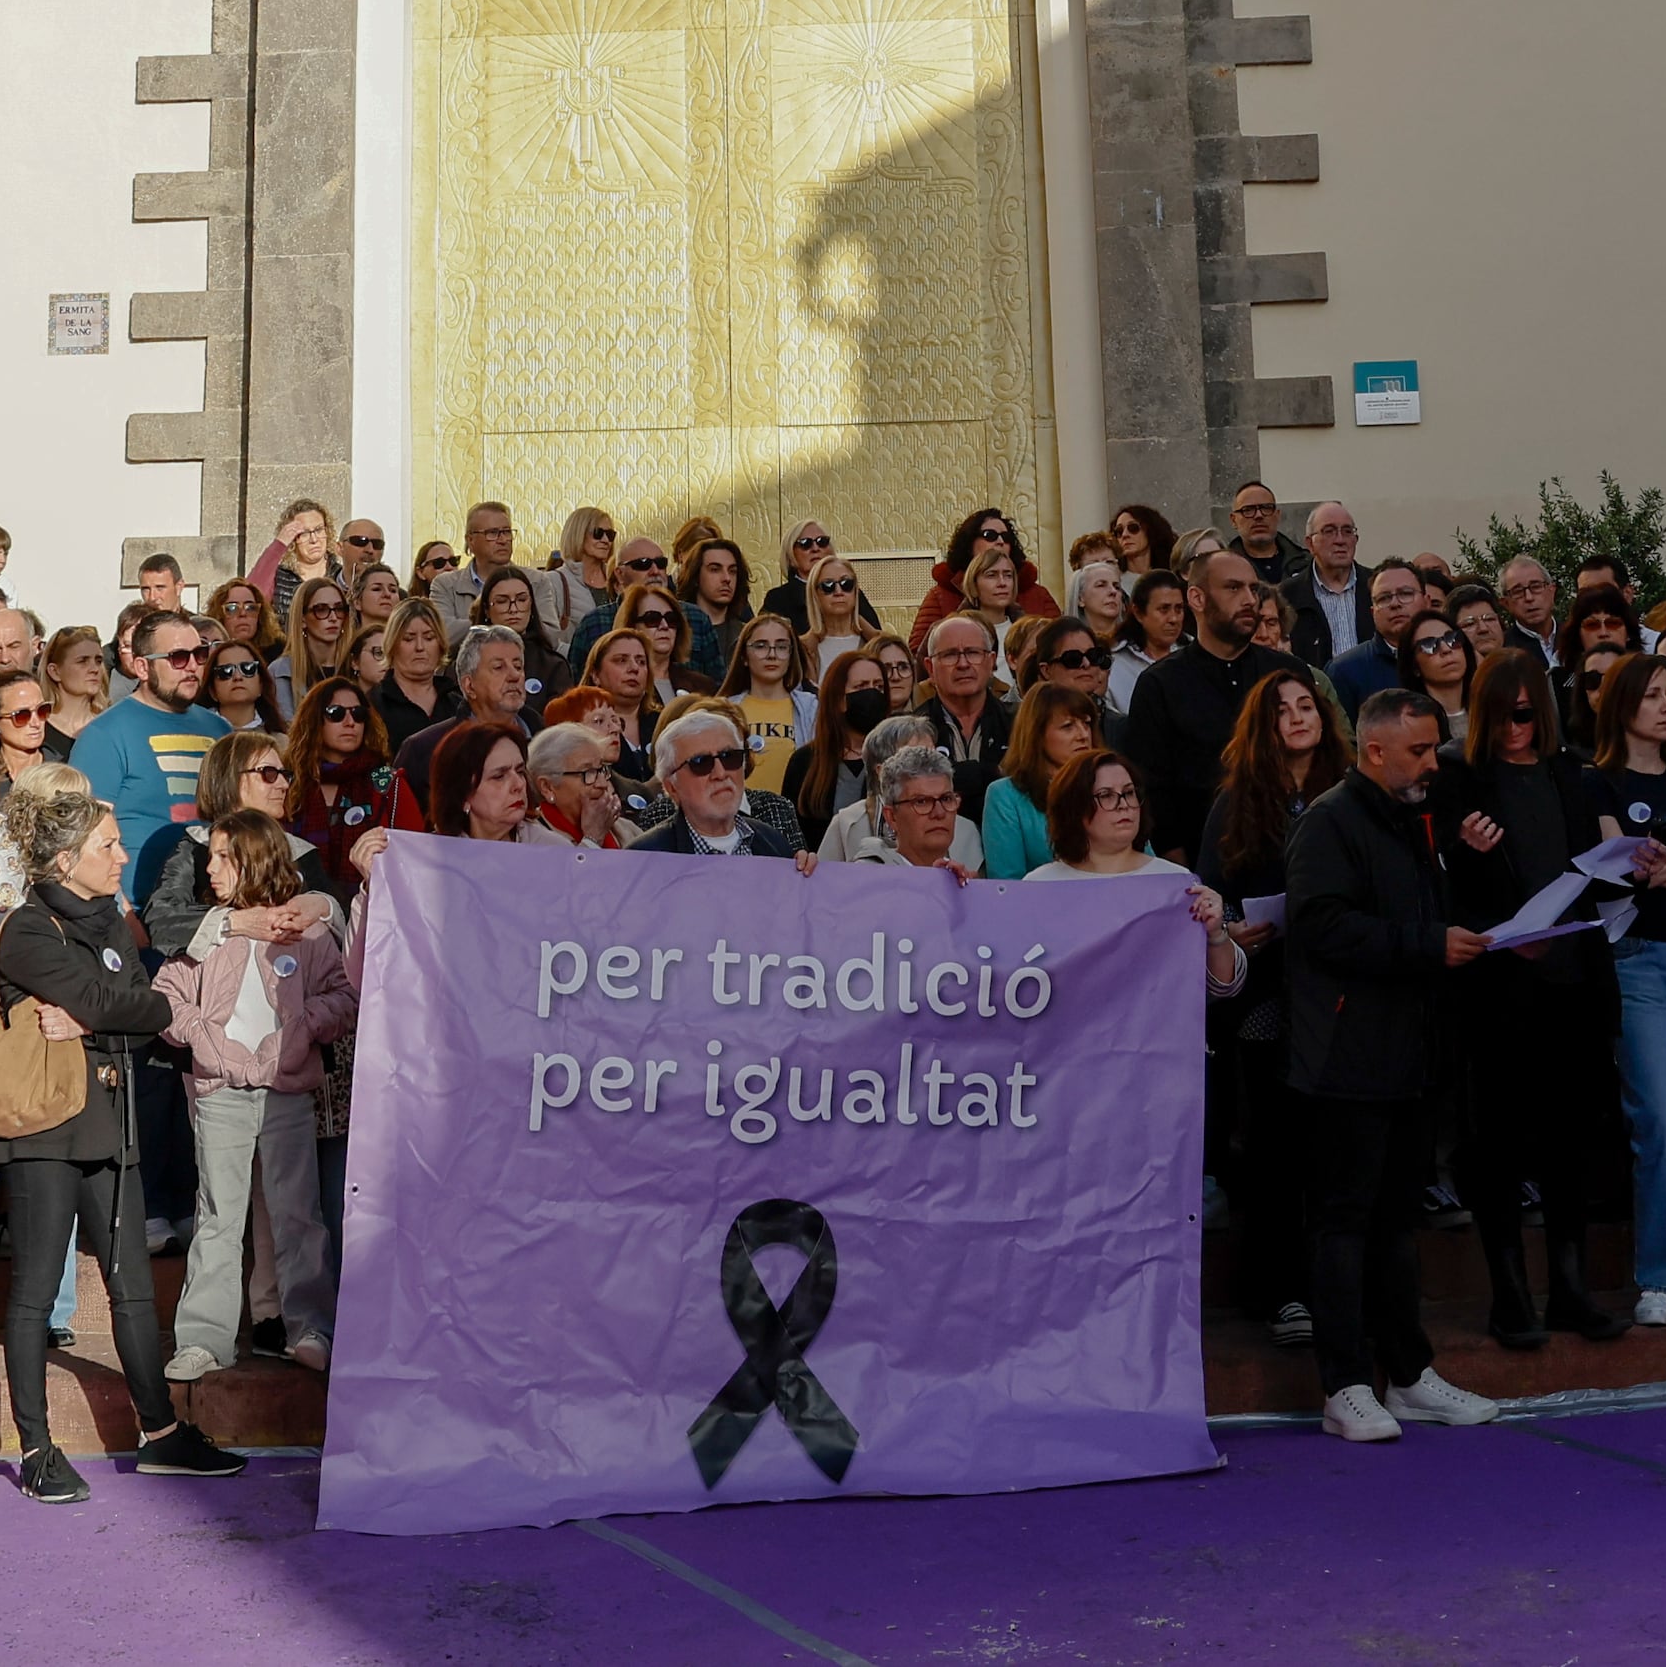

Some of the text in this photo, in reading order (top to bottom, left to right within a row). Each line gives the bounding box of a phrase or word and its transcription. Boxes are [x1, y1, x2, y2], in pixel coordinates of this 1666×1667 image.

[59, 305, 95, 315] ERMITA
[65, 319, 92, 327] DE LA
[67, 327, 92, 336] SANG
[537, 931, 1053, 1019] per tradició
[529, 1039, 1039, 1145] per igualtat
